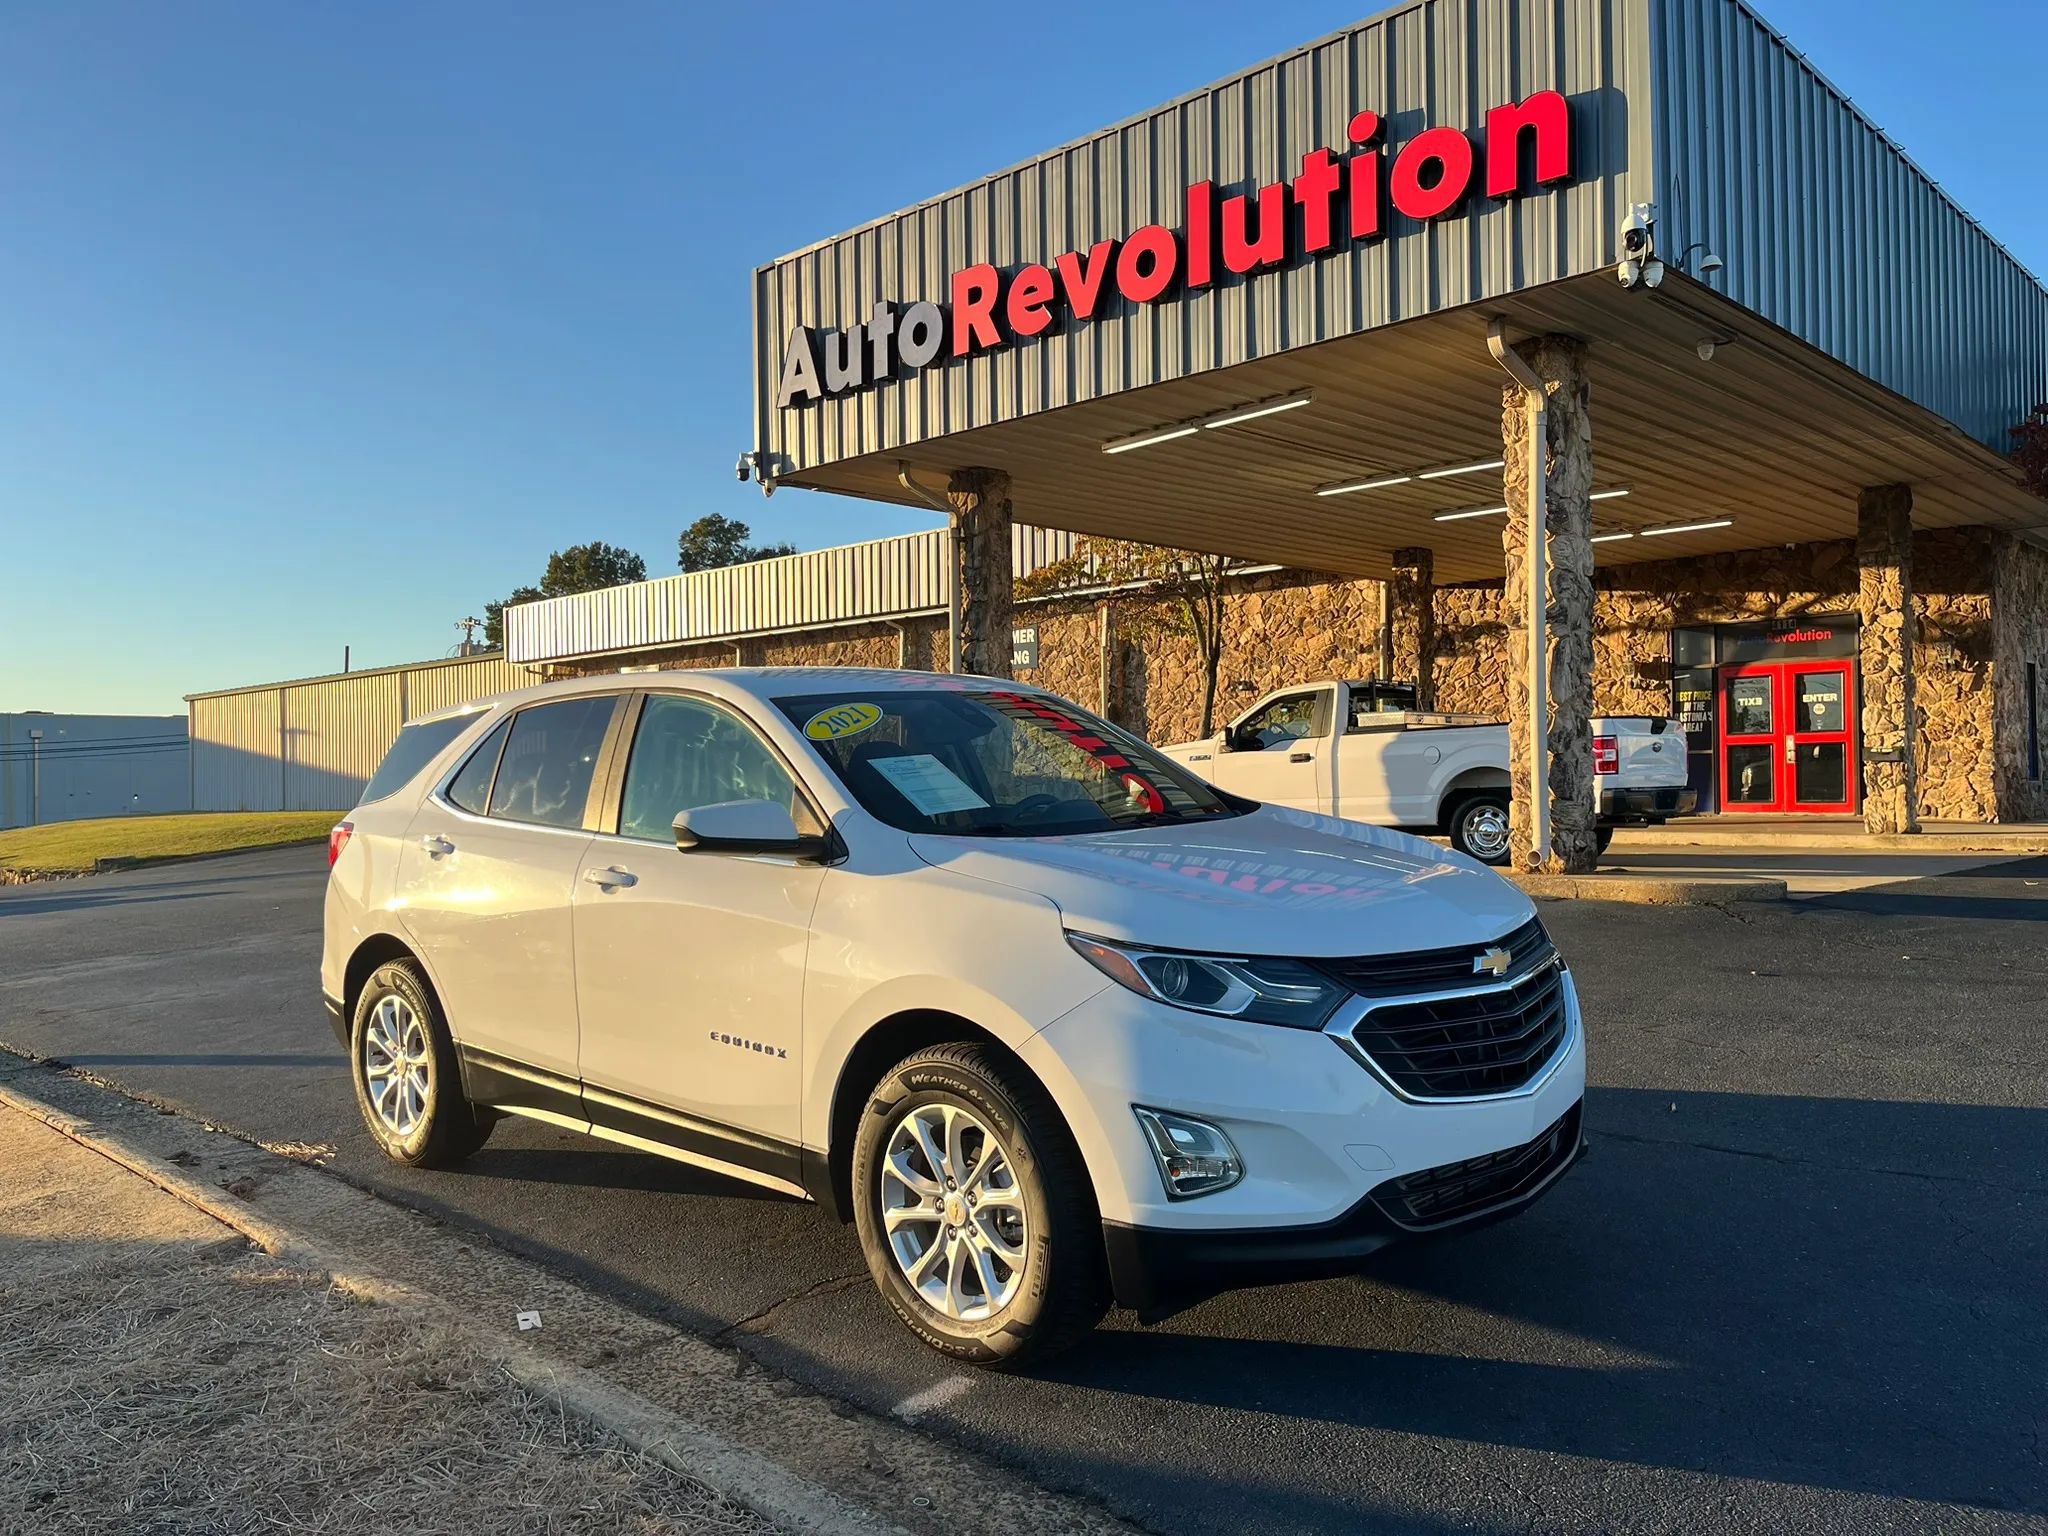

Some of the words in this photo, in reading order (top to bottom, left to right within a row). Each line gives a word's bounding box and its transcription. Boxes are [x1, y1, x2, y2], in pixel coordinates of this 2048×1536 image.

[1802, 693, 1838, 703] ENTER
[1683, 702, 1692, 712] IN
[1693, 701, 1706, 711] THE
[817, 705, 871, 735] 2021
